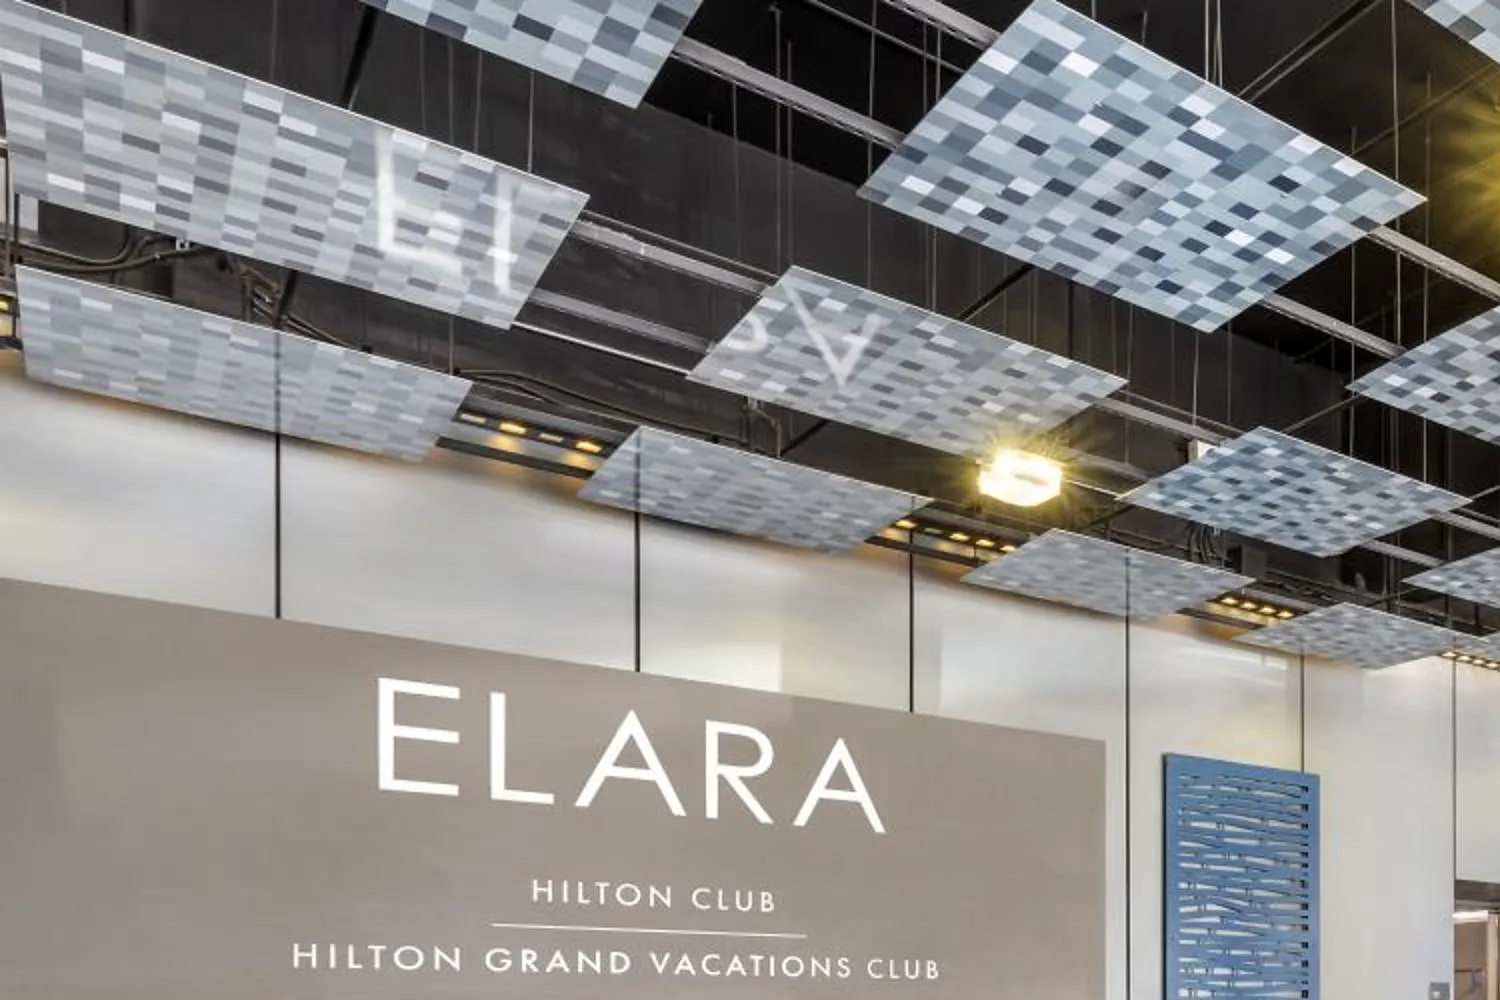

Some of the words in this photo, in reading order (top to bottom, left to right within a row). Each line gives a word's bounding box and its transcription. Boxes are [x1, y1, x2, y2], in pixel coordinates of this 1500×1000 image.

[378, 677, 886, 833] ELARA
[532, 879, 671, 908] HILTON
[691, 887, 775, 913] CLUB
[293, 943, 461, 972] HILTON
[485, 947, 631, 974] GRAND
[649, 952, 851, 978] VACATIONS
[867, 958, 939, 980] CLUB
